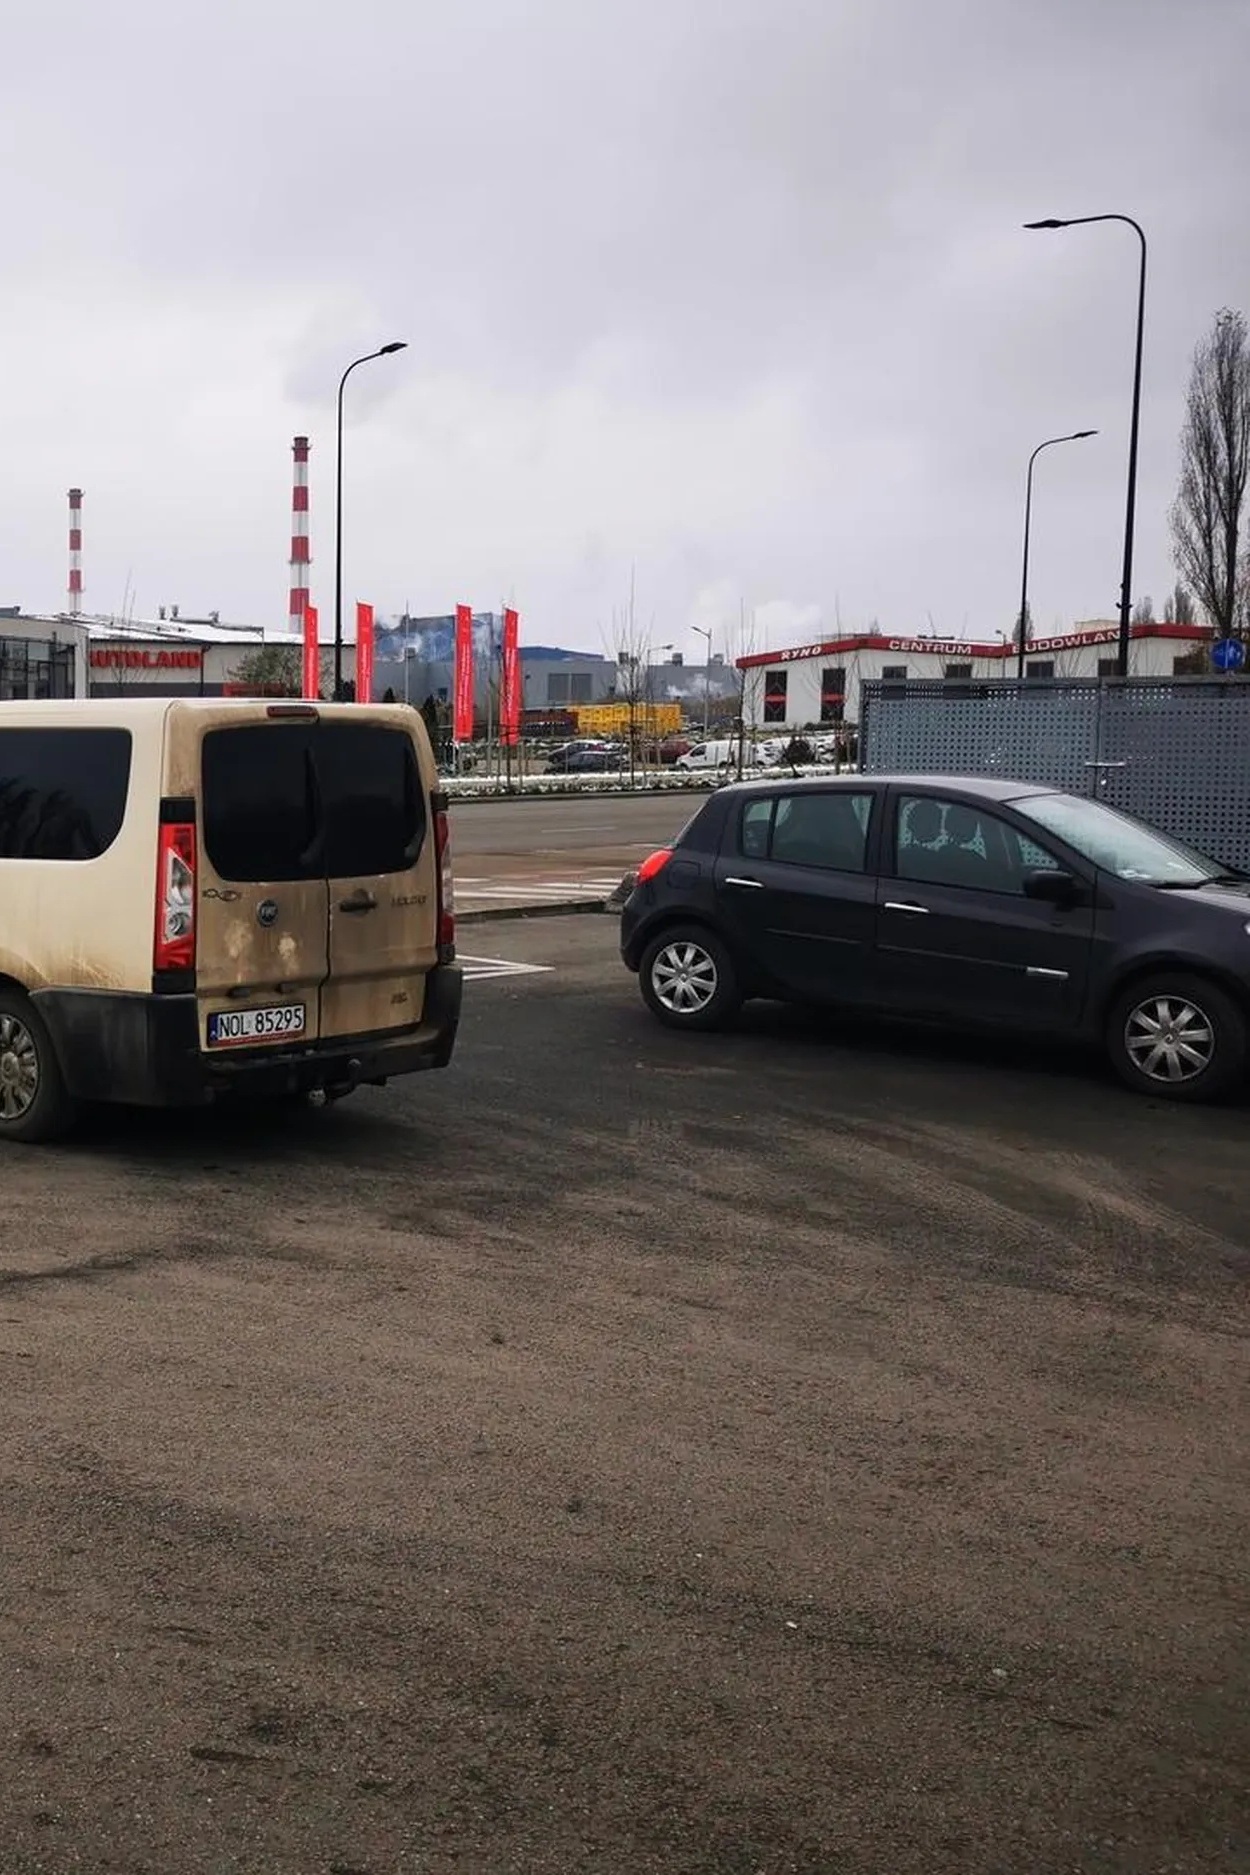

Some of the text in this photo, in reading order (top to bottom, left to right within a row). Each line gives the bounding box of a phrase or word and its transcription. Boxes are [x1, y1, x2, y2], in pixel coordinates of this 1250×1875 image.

[888, 639, 972, 655] CENTRUM
[219, 1008, 303, 1038] NOL 85295
